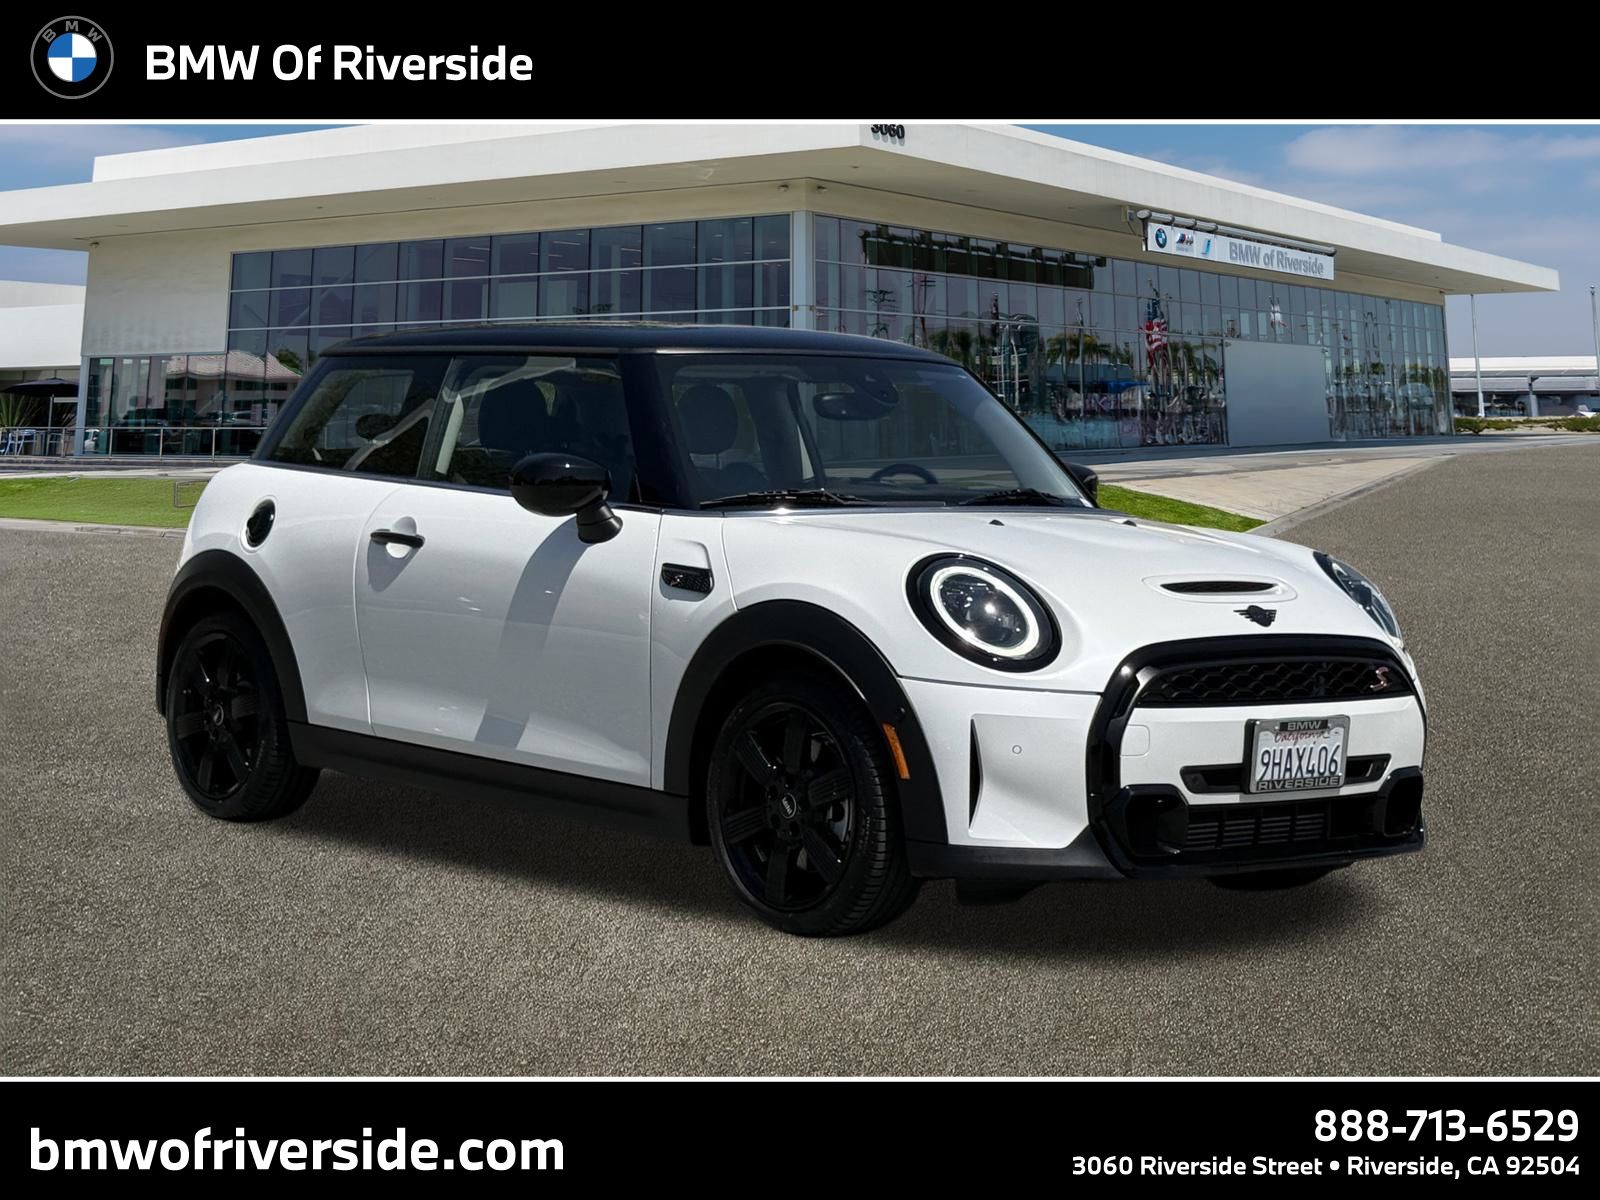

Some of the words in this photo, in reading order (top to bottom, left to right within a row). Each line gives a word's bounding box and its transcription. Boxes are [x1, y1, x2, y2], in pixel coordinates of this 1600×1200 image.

[1229, 242, 1261, 265] BMW
[1263, 249, 1275, 267] of
[1276, 250, 1324, 275] Riverside
[1288, 721, 1321, 731] BMW
[1259, 744, 1340, 780] 9HAX406
[1258, 776, 1340, 791] RIVERSIDE
